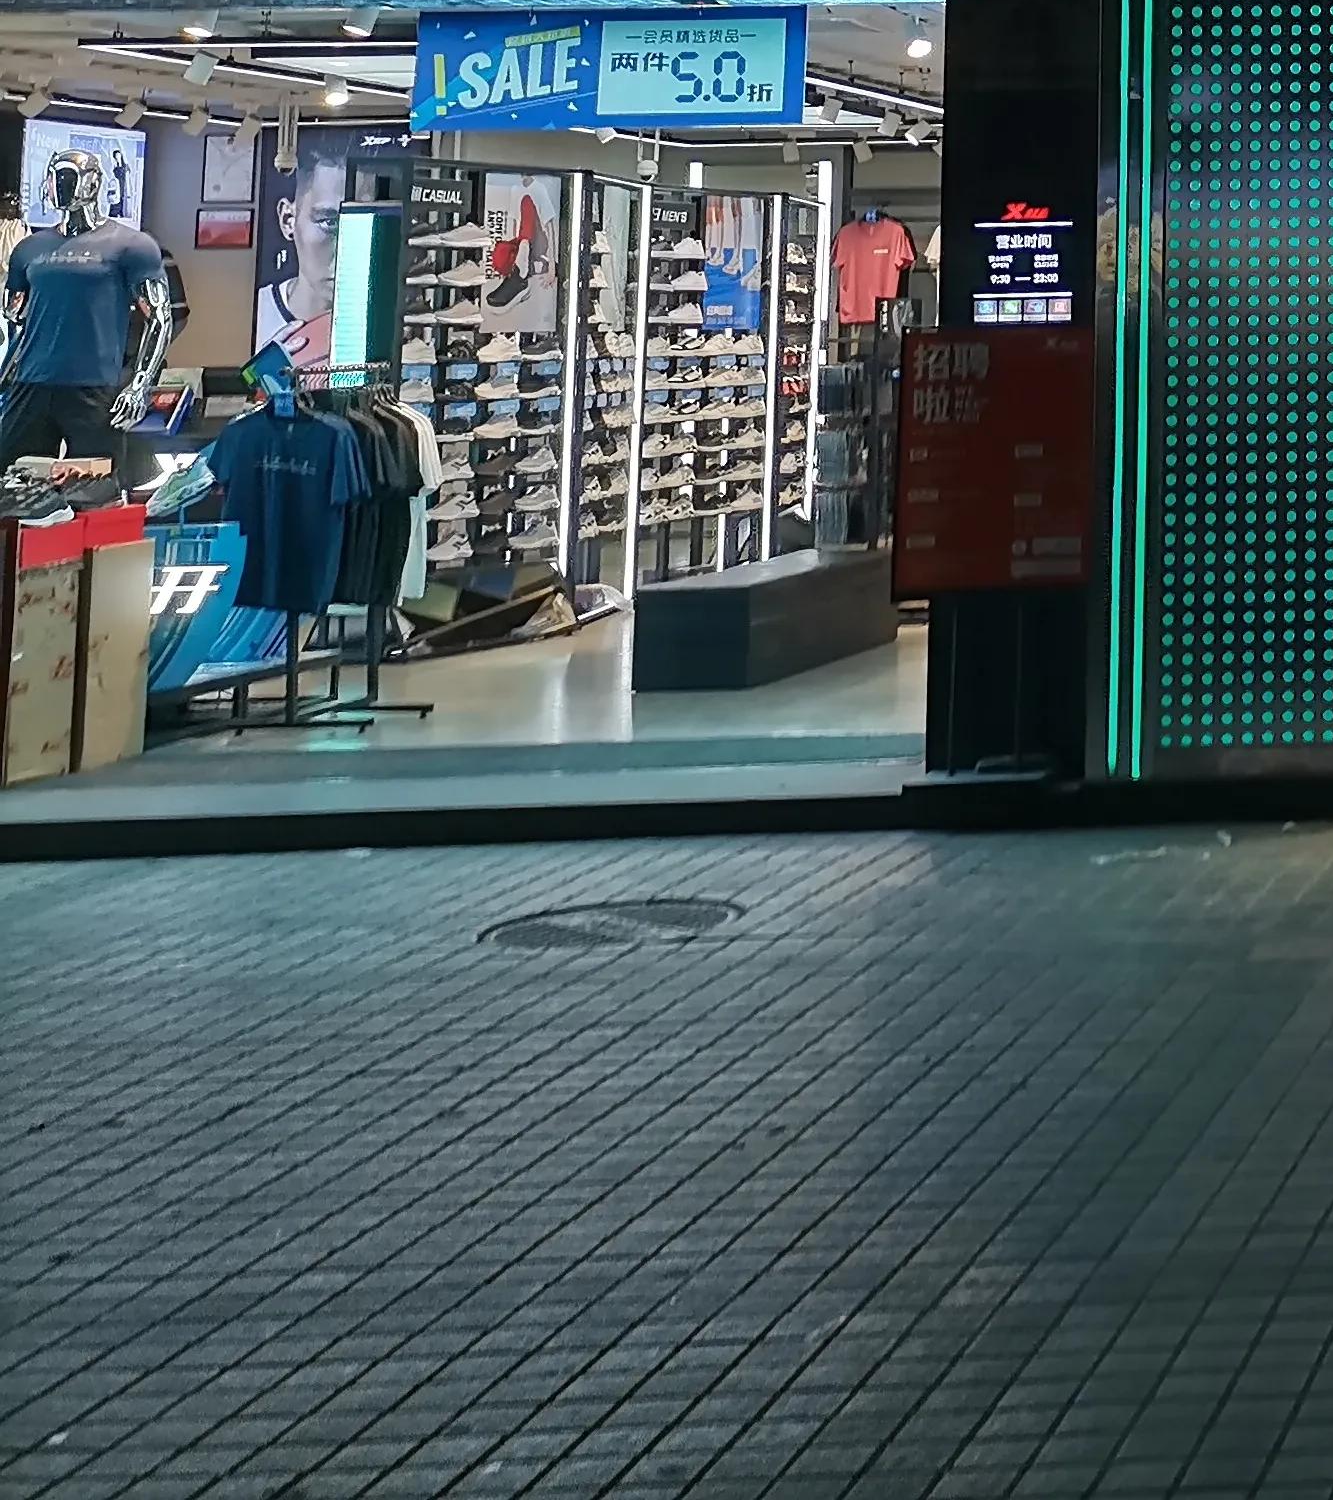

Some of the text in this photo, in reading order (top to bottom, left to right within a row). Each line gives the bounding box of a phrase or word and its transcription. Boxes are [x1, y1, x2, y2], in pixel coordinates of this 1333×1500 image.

[643, 28, 740, 45] 会员精选货品
[421, 188, 463, 205] CASUAL
[995, 233, 1052, 249] 营业时间
[912, 341, 991, 381] 招聘
